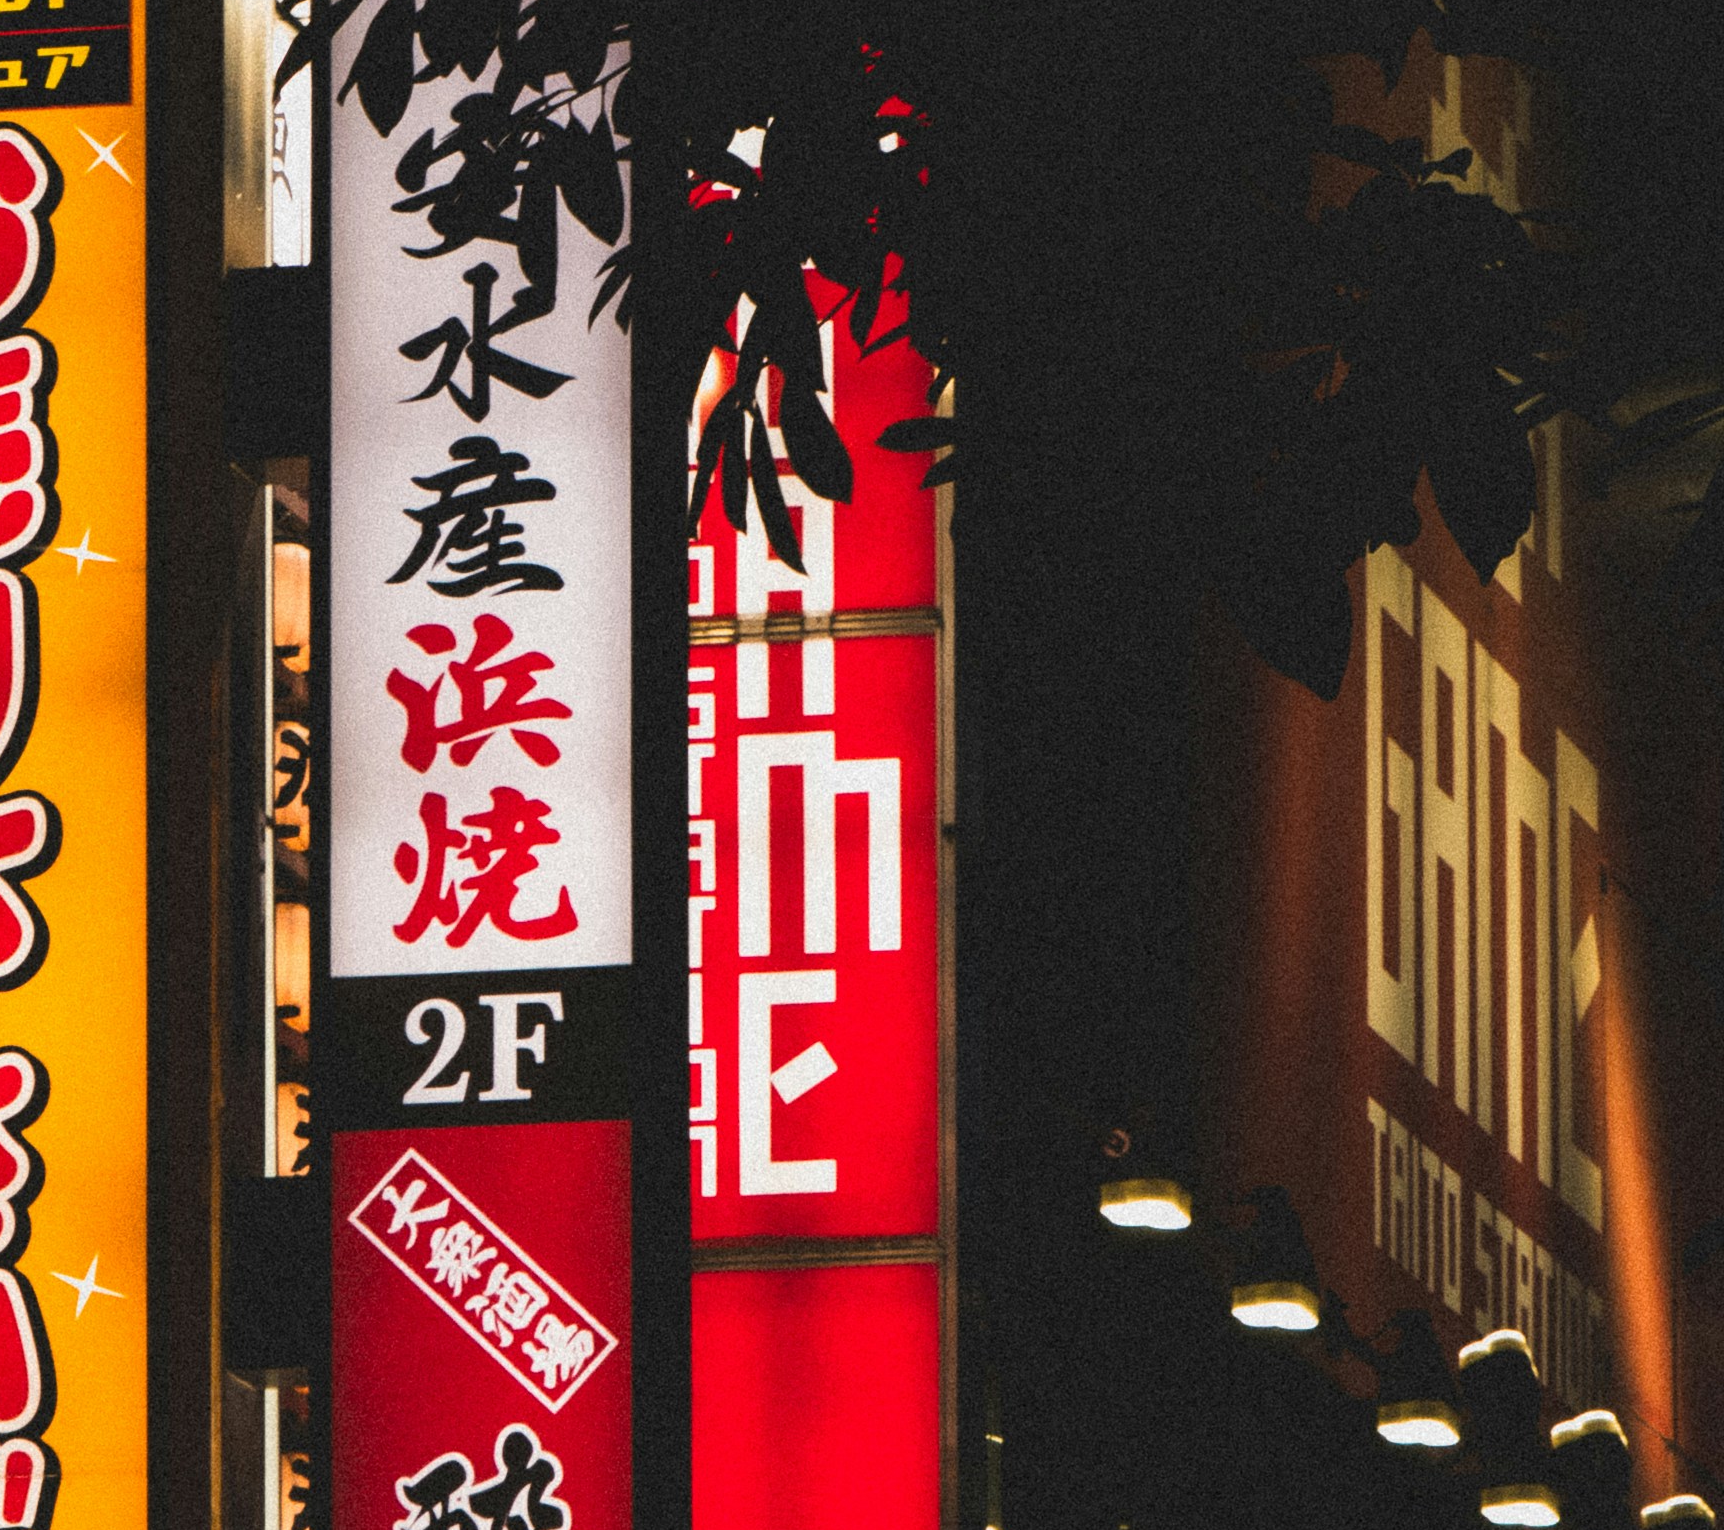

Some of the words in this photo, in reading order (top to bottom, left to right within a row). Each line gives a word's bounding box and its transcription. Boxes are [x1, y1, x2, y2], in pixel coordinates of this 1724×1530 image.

[1365, 537, 1603, 1233] GAME
[401, 991, 565, 1106] 2F
[1367, 1095, 1462, 1315] TAITO
